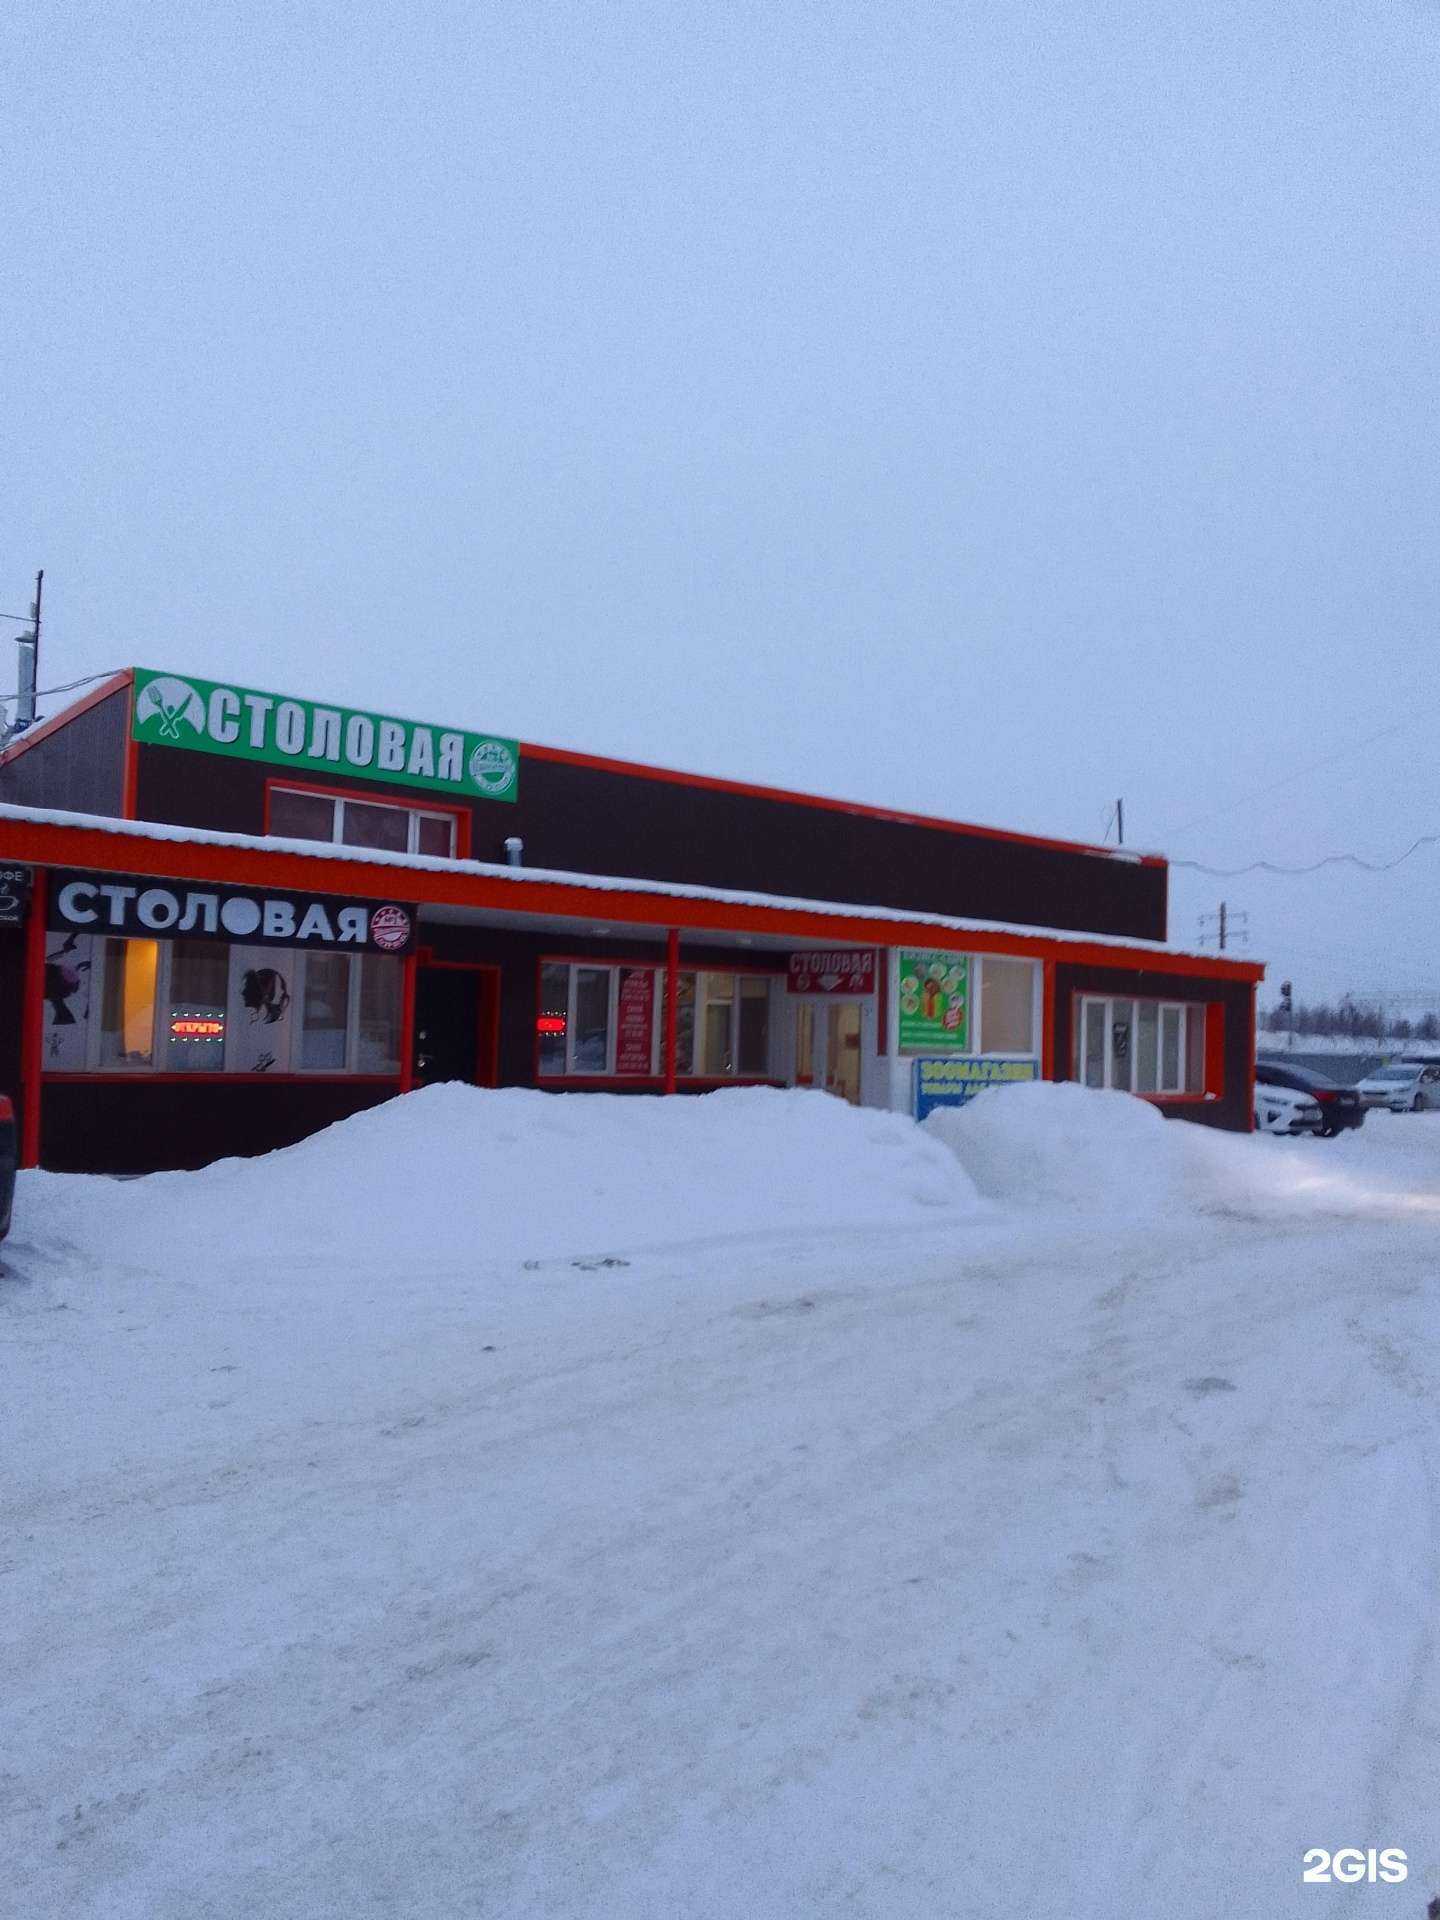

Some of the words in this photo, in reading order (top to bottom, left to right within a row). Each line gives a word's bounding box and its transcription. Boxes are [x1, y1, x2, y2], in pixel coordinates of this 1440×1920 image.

[206, 687, 465, 783] СТОЛОВАЯ
[58, 881, 369, 944] СТОЛОВАЯ
[790, 952, 873, 975] СТОЛОВАЯ
